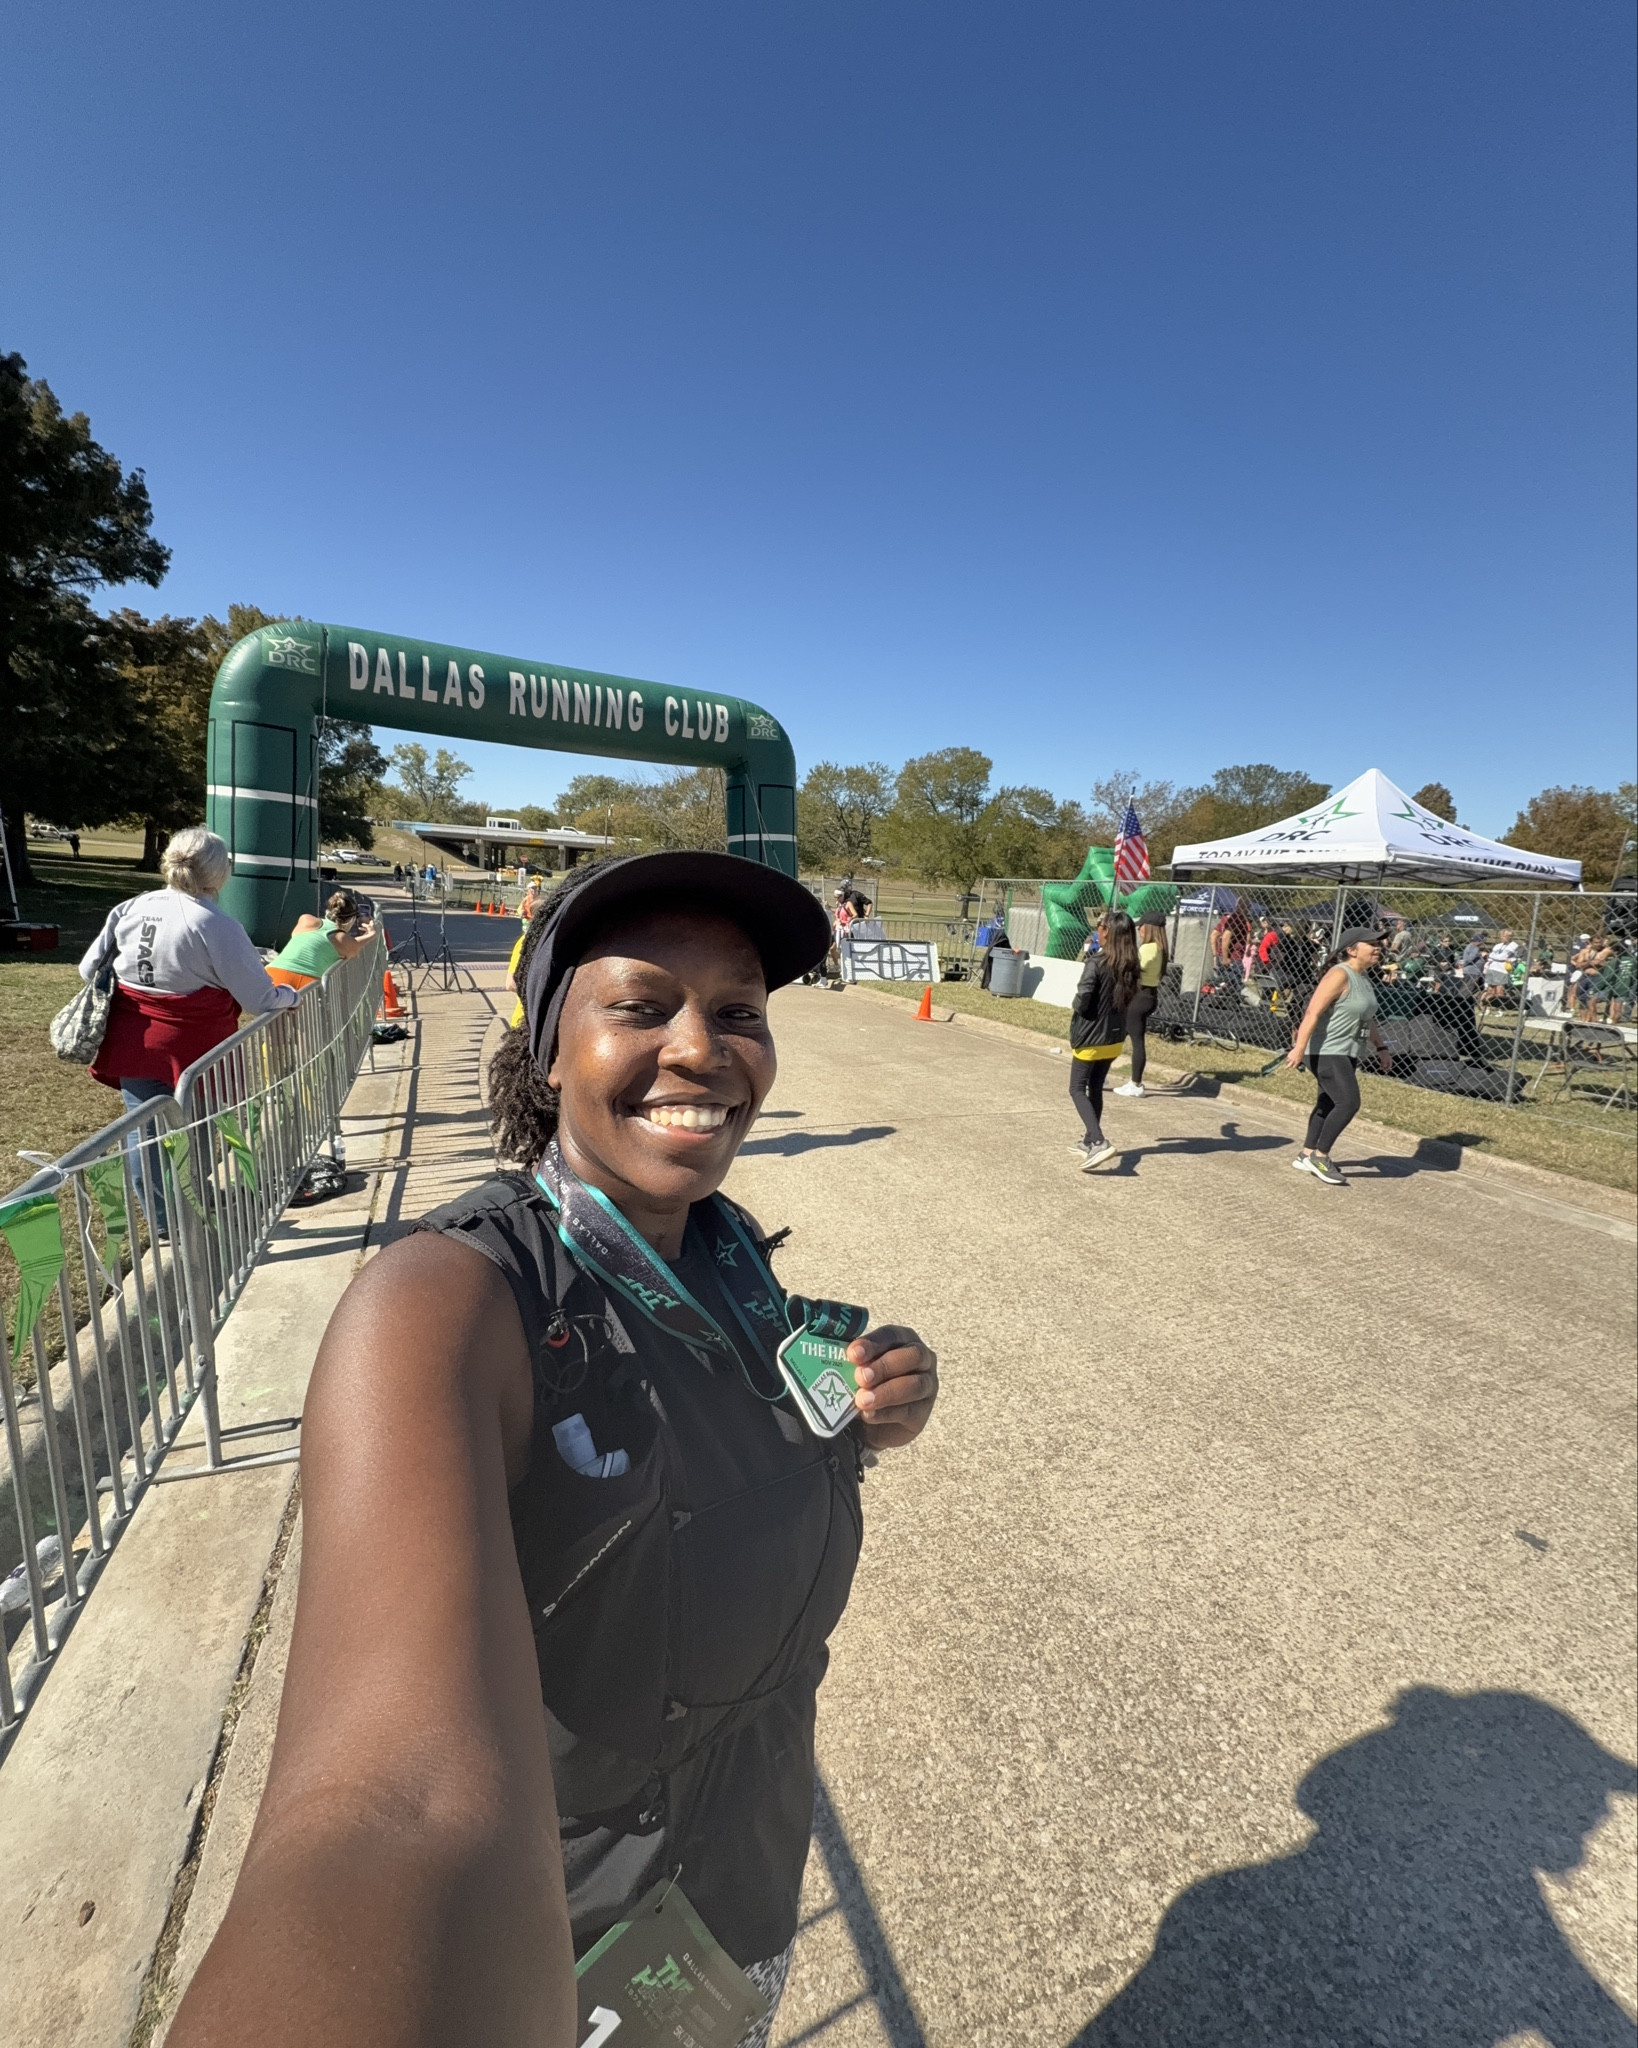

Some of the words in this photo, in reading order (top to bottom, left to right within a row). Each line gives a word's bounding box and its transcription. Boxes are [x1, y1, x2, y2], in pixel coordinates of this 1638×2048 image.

[268, 650, 316, 671] DRC
[347, 641, 486, 709] DALLAS
[508, 670, 644, 732] RUNNING
[664, 695, 730, 744] CLUB
[751, 726, 778, 738] DRC
[1256, 830, 1332, 842] DRC
[1420, 833, 1492, 851] DRC
[572, 1217, 608, 1255] DALLAS
[800, 1341, 826, 1358] THE
[829, 1345, 851, 1361] HA
[811, 1373, 827, 1391] DALLAS
[542, 1520, 631, 1617] SOMON
[682, 1952, 705, 1982] DALLAS
